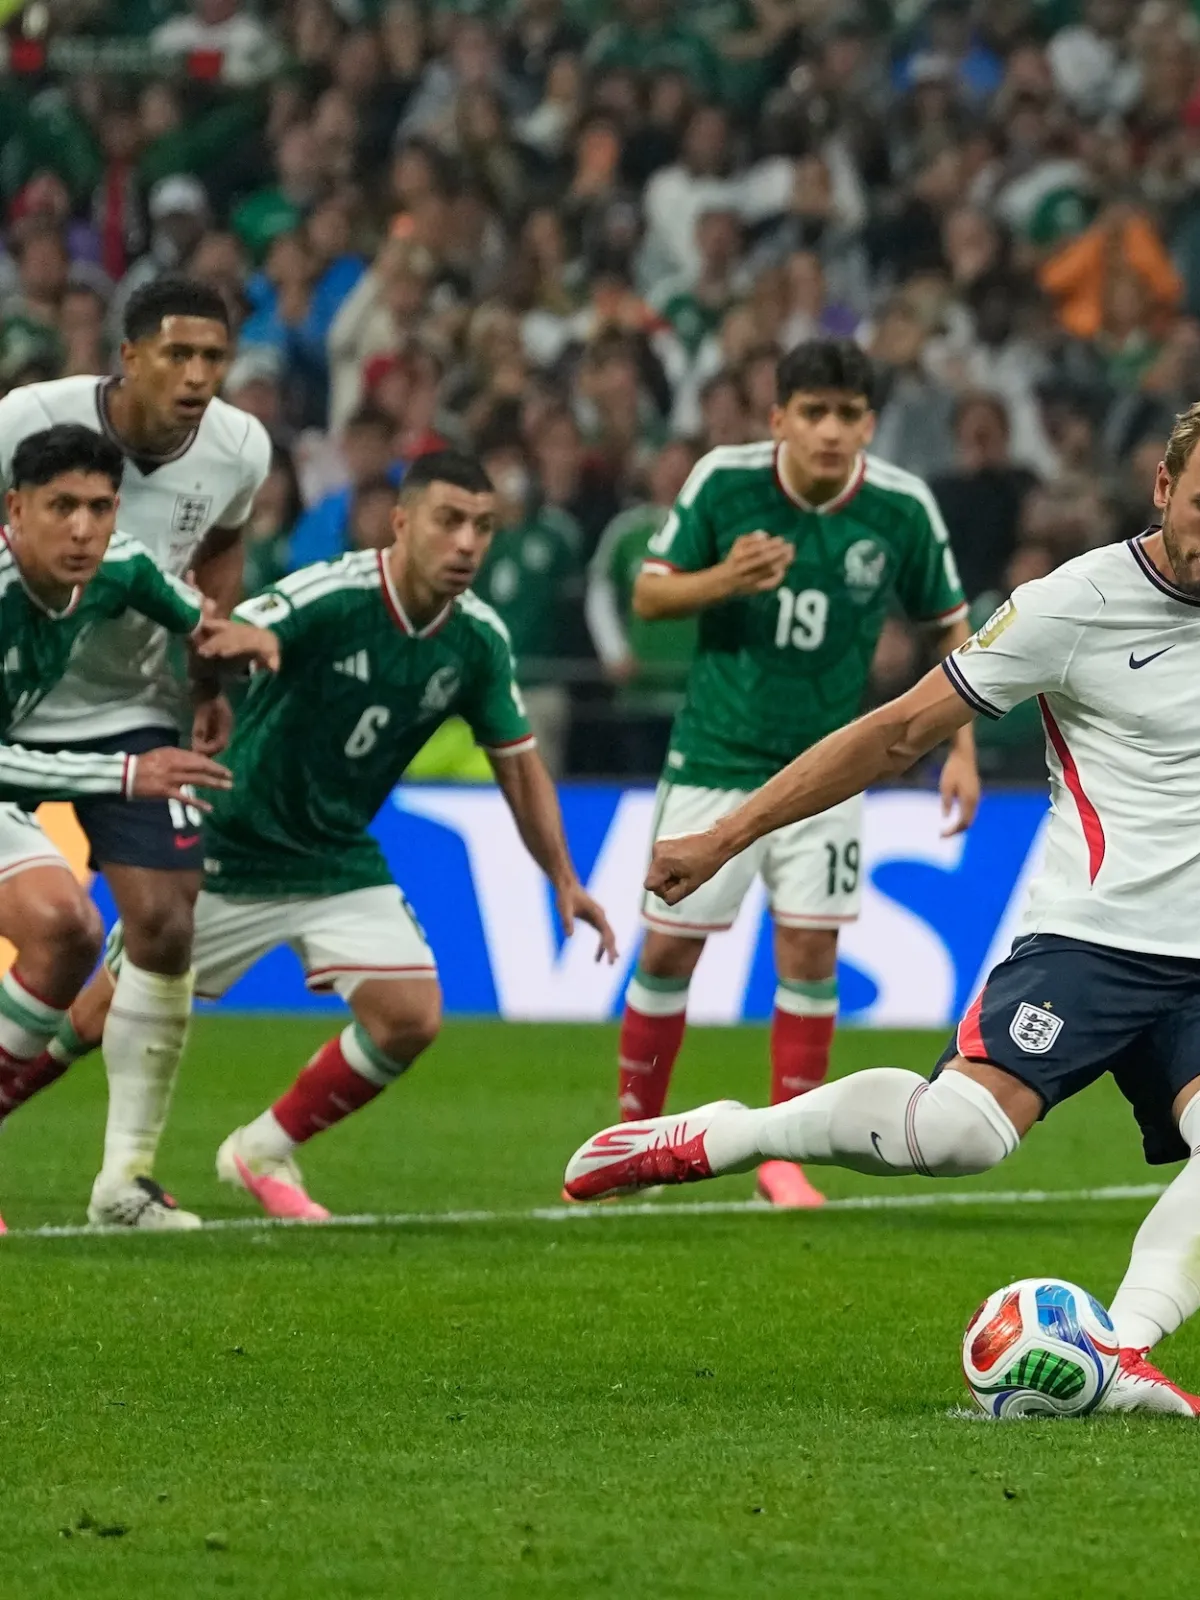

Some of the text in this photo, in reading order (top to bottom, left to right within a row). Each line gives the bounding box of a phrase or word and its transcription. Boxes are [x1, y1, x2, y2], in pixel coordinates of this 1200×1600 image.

[775, 587, 829, 651] 19
[344, 705, 390, 758] 6
[825, 840, 860, 896] 19
[392, 787, 1056, 1028] VS
